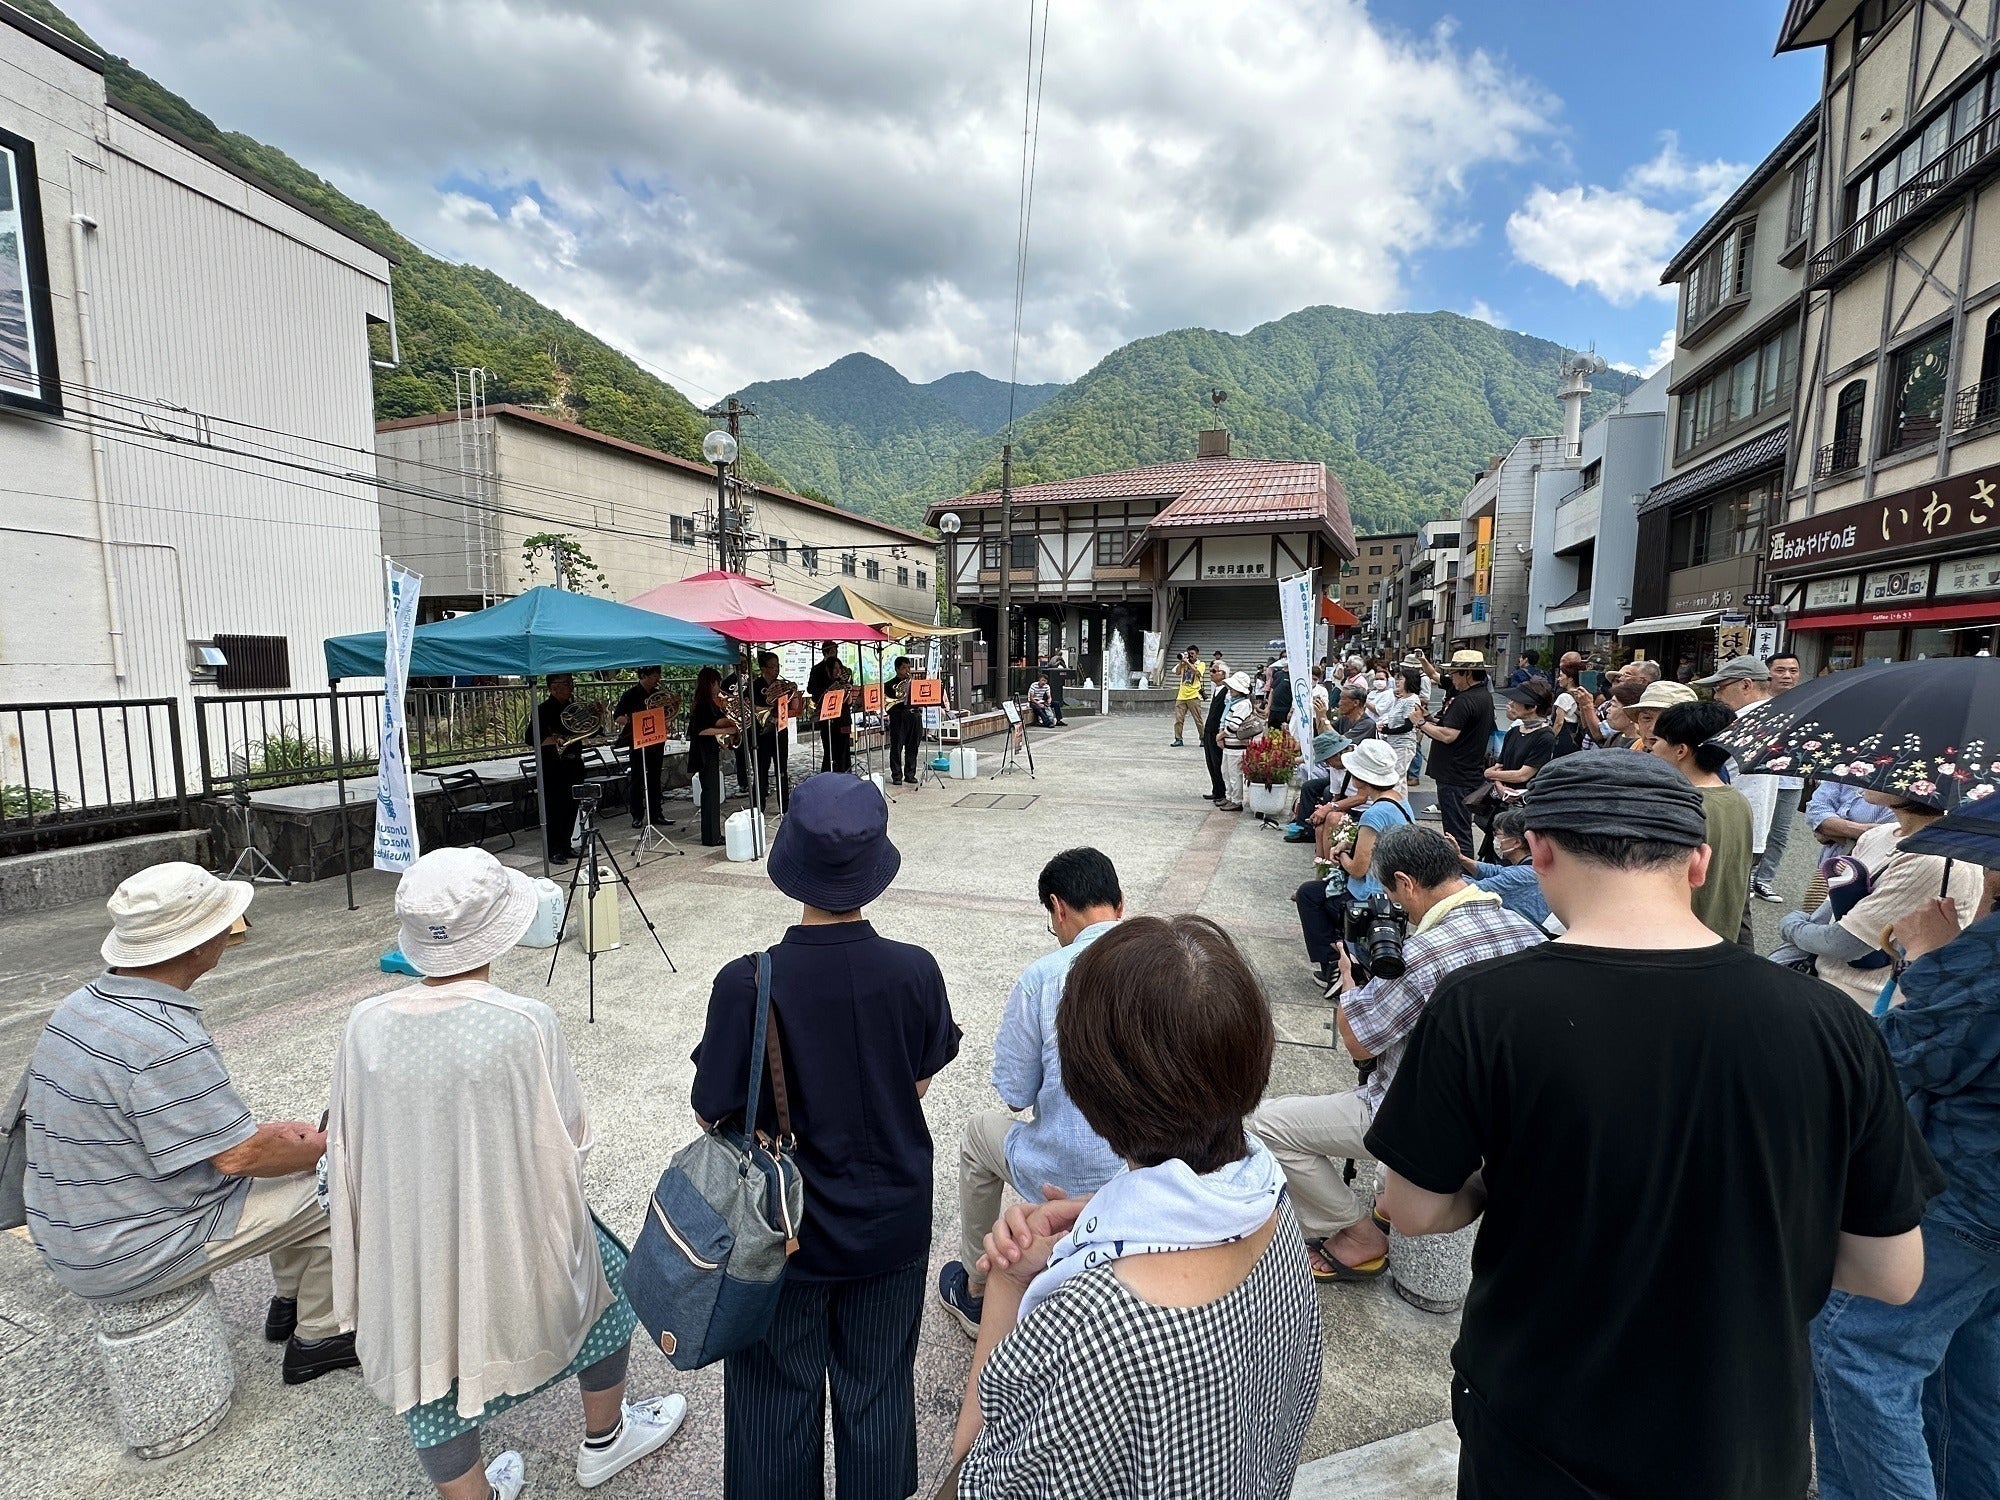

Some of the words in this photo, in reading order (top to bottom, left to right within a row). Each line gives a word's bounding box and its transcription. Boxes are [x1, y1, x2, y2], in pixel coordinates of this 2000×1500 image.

[1881, 479, 1998, 541] いわさ
[1207, 563, 1265, 575] 宇奈月温泉駅
[1954, 573, 1980, 589] 喫茶
